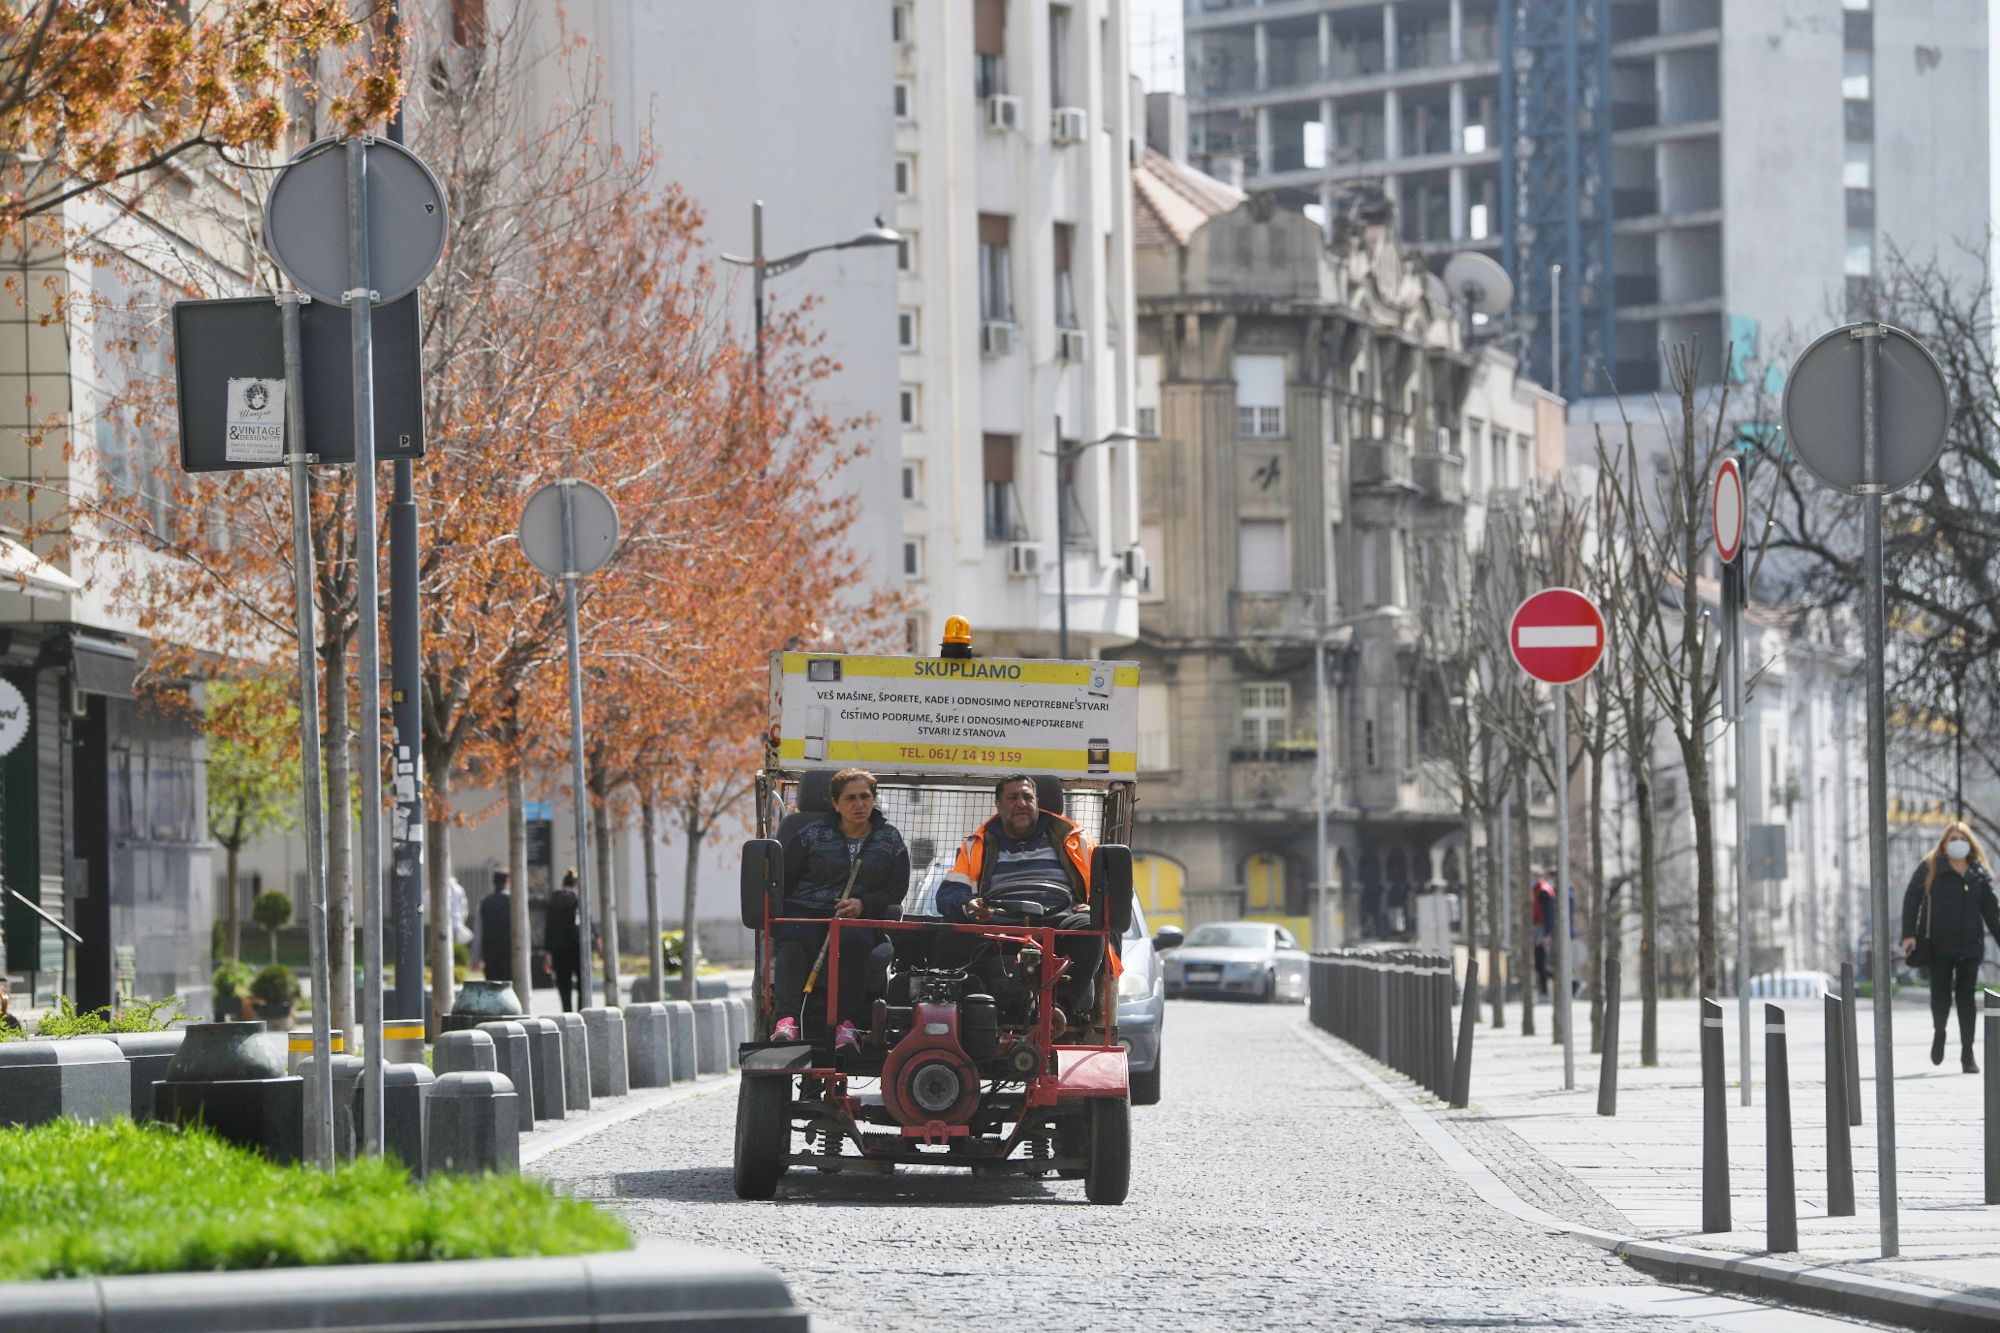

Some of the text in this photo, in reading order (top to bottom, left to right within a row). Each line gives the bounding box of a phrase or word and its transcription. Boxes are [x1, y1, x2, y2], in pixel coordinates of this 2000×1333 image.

[229, 426, 281, 440] & VINTAGE
[914, 661, 1021, 679] SKUPLJAMO
[817, 690, 1109, 711] VEŠ MAŠINE, ŠPORETE, KADE I ODNOSIMO NEPOTREBNE STVARI
[840, 709, 879, 721] ČISTIMO
[882, 713, 933, 724] PODRUME,
[935, 713, 959, 724] ŠUPE
[967, 716, 1021, 726] ODNOSIMO
[1023, 718, 1084, 729] NEPOTREBNE
[918, 726, 1006, 738] STVARI IZ STANOVA
[900, 747, 1022, 762] TEL. 061/ 14 19 159
